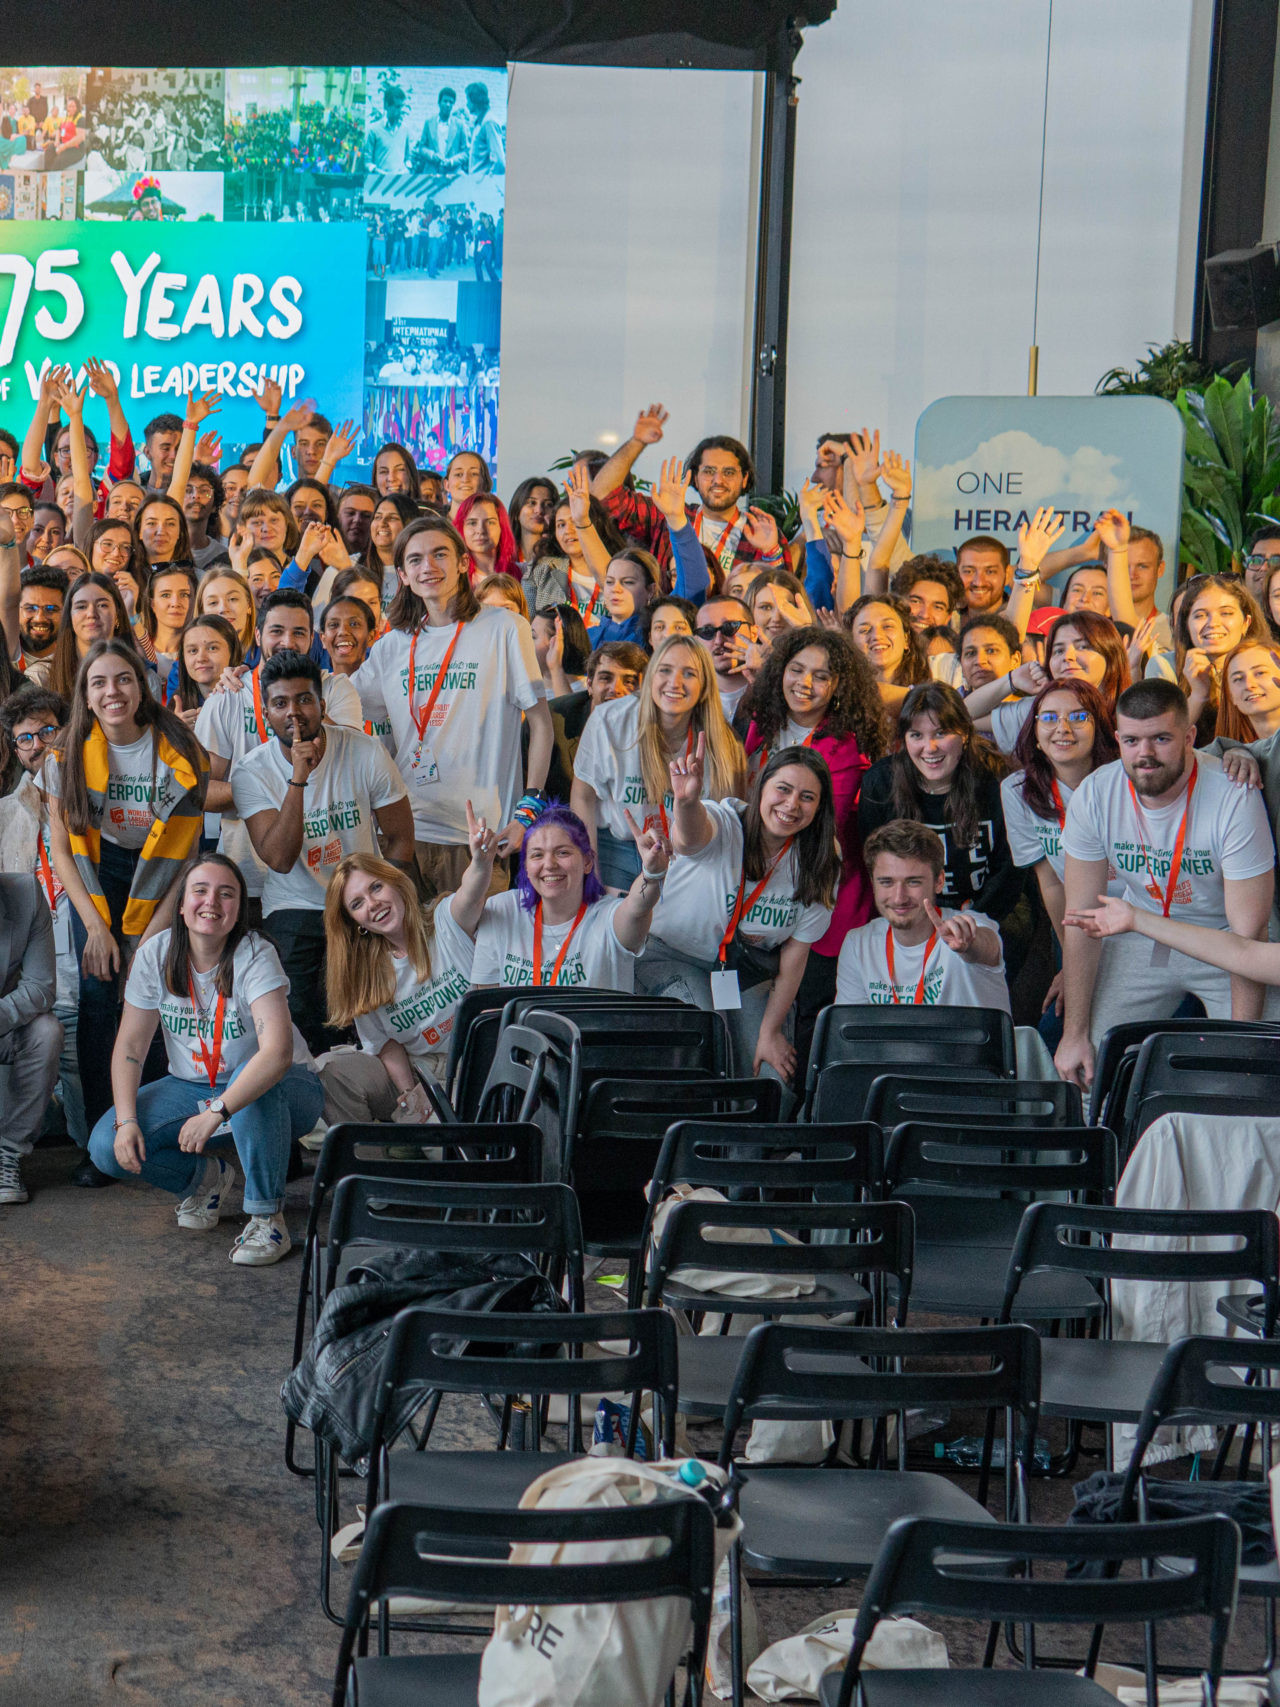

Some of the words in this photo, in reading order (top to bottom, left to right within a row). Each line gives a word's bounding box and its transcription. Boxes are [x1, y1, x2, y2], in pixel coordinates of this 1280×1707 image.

[110, 250, 303, 341] YEARS
[131, 361, 305, 399] LEADERSHIP
[956, 471, 1023, 495] ONE
[1114, 841, 1135, 851] make
[1116, 852, 1215, 878] SUPERPWER
[869, 981, 887, 991] make
[160, 1003, 179, 1014] make
[390, 972, 471, 1033] SUPERPOWER
